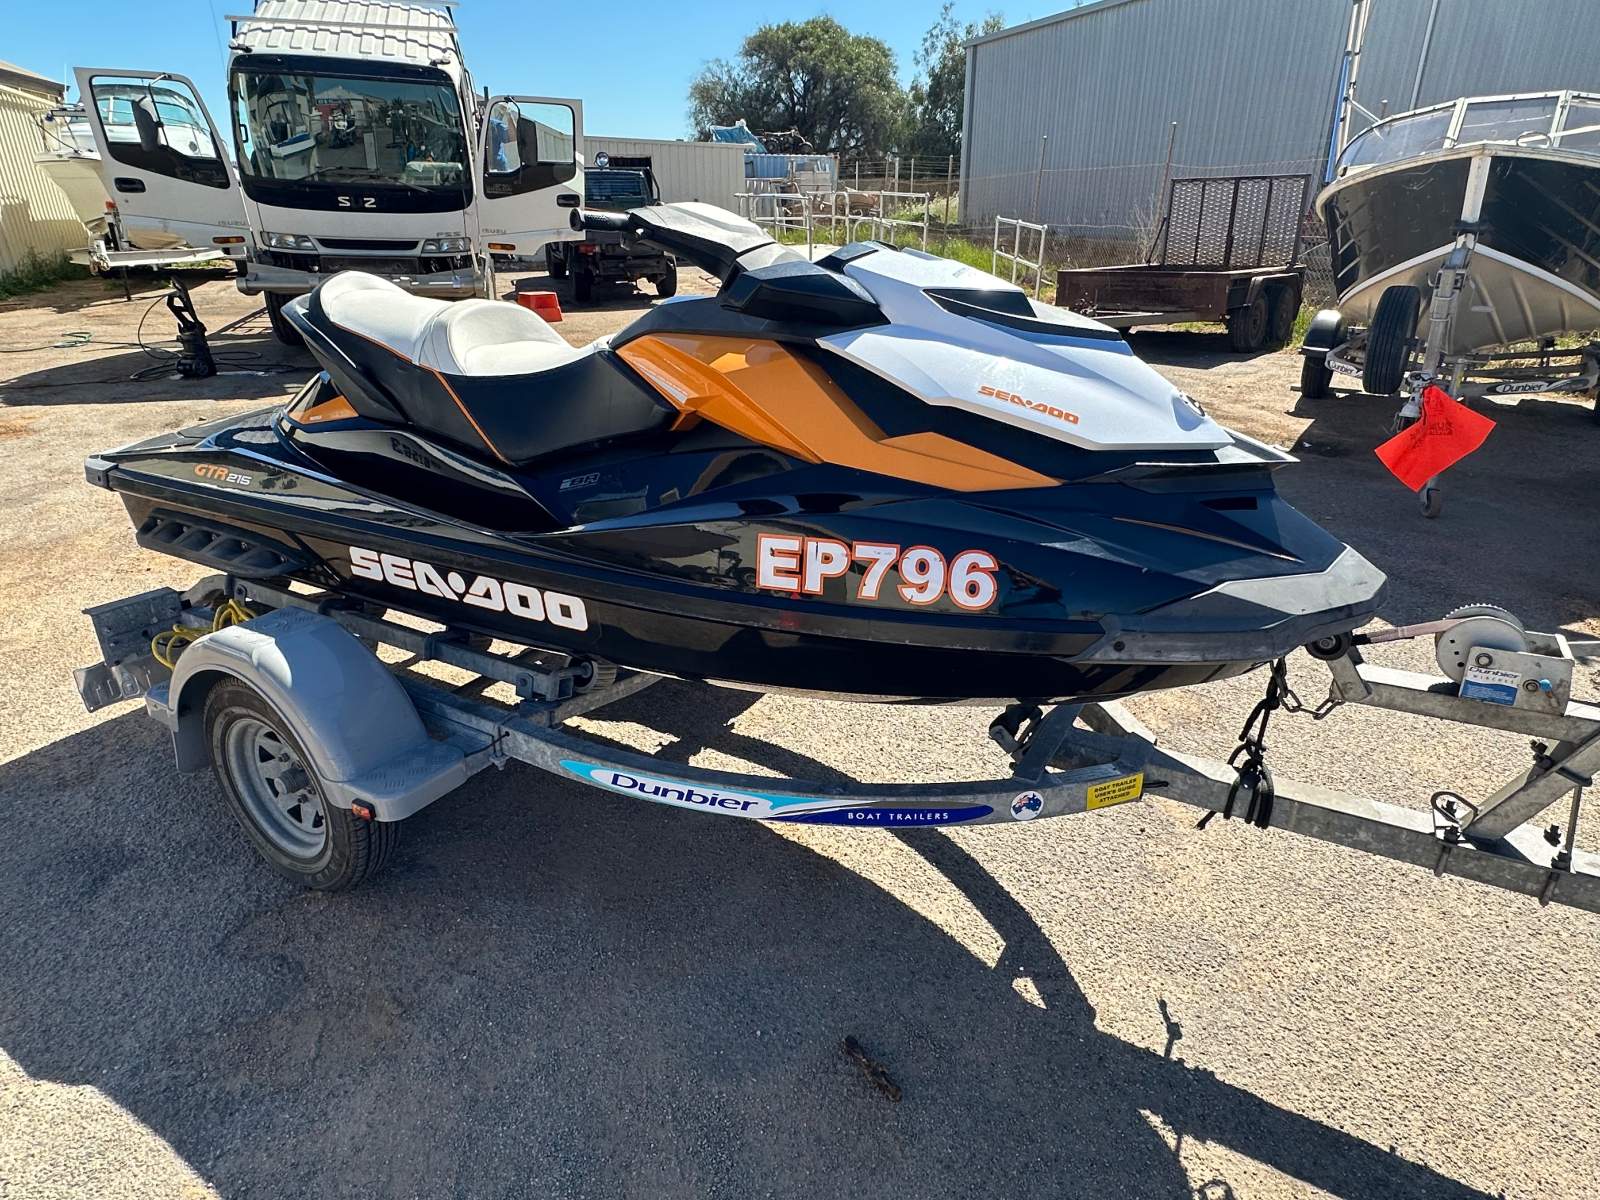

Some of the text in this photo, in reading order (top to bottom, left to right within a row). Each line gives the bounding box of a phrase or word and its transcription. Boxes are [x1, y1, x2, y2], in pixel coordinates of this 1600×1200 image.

[1502, 382, 1544, 394] Dunbier
[194, 463, 252, 486] GTR 215
[756, 533, 1000, 611] EP796
[1468, 665, 1520, 679] Dunbier
[611, 773, 759, 811] Dunbier
[1094, 778, 1137, 793] BOAT TRAILER
[1099, 791, 1130, 802] ATTACHED
[847, 812, 949, 821] BOAT TRAILERS
